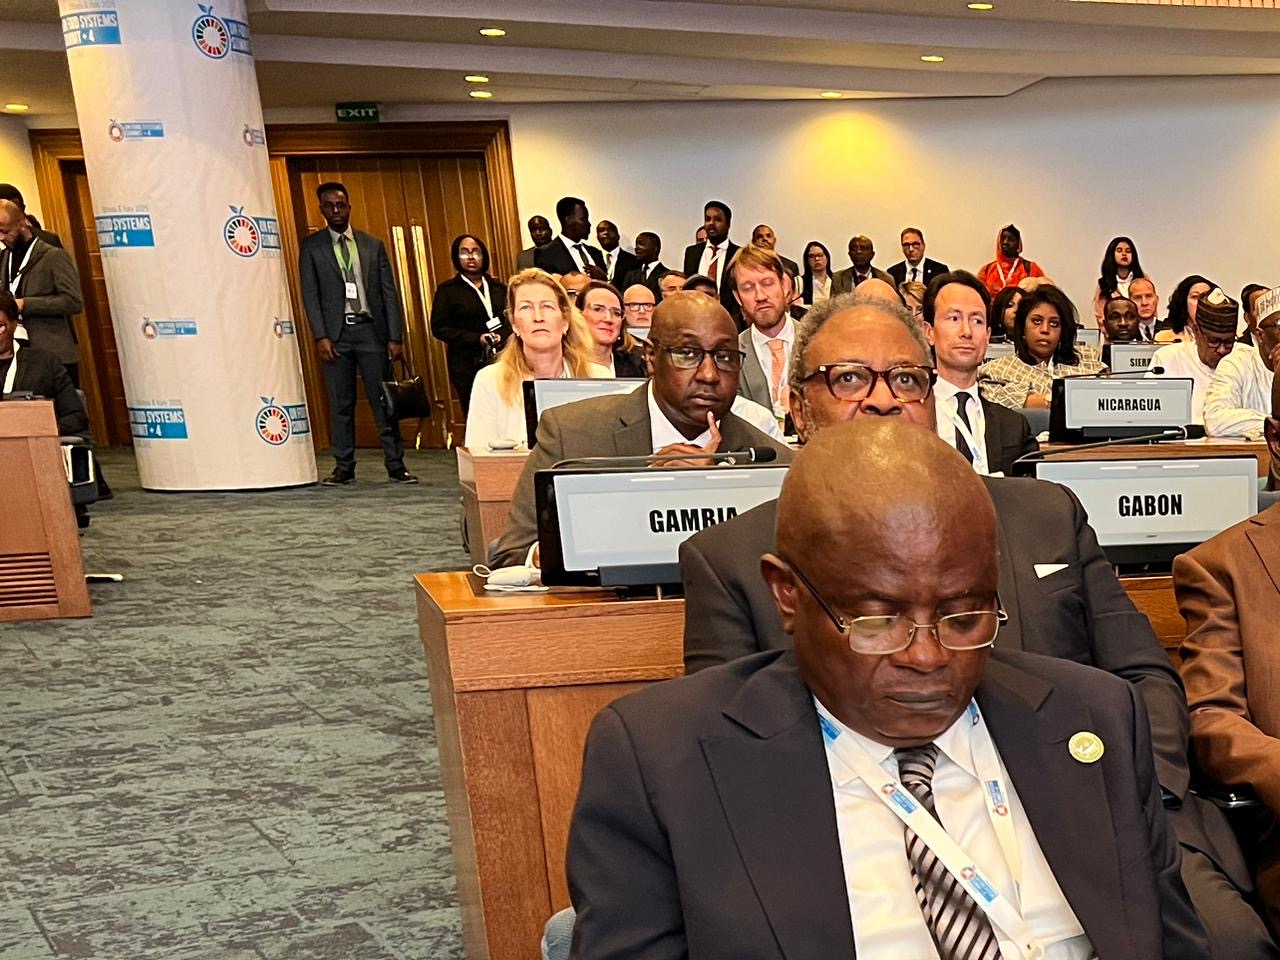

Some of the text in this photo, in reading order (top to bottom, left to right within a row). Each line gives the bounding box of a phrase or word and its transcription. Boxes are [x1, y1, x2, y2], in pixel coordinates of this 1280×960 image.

[79, 13, 117, 28] SYSTEMS
[337, 108, 376, 117] EXIT
[113, 217, 151, 231] SYSTEMS
[1130, 358, 1152, 367] SIER
[1098, 398, 1161, 411] NICARAGUA
[146, 410, 184, 424] SYSTEMS
[1119, 494, 1183, 517] GABON
